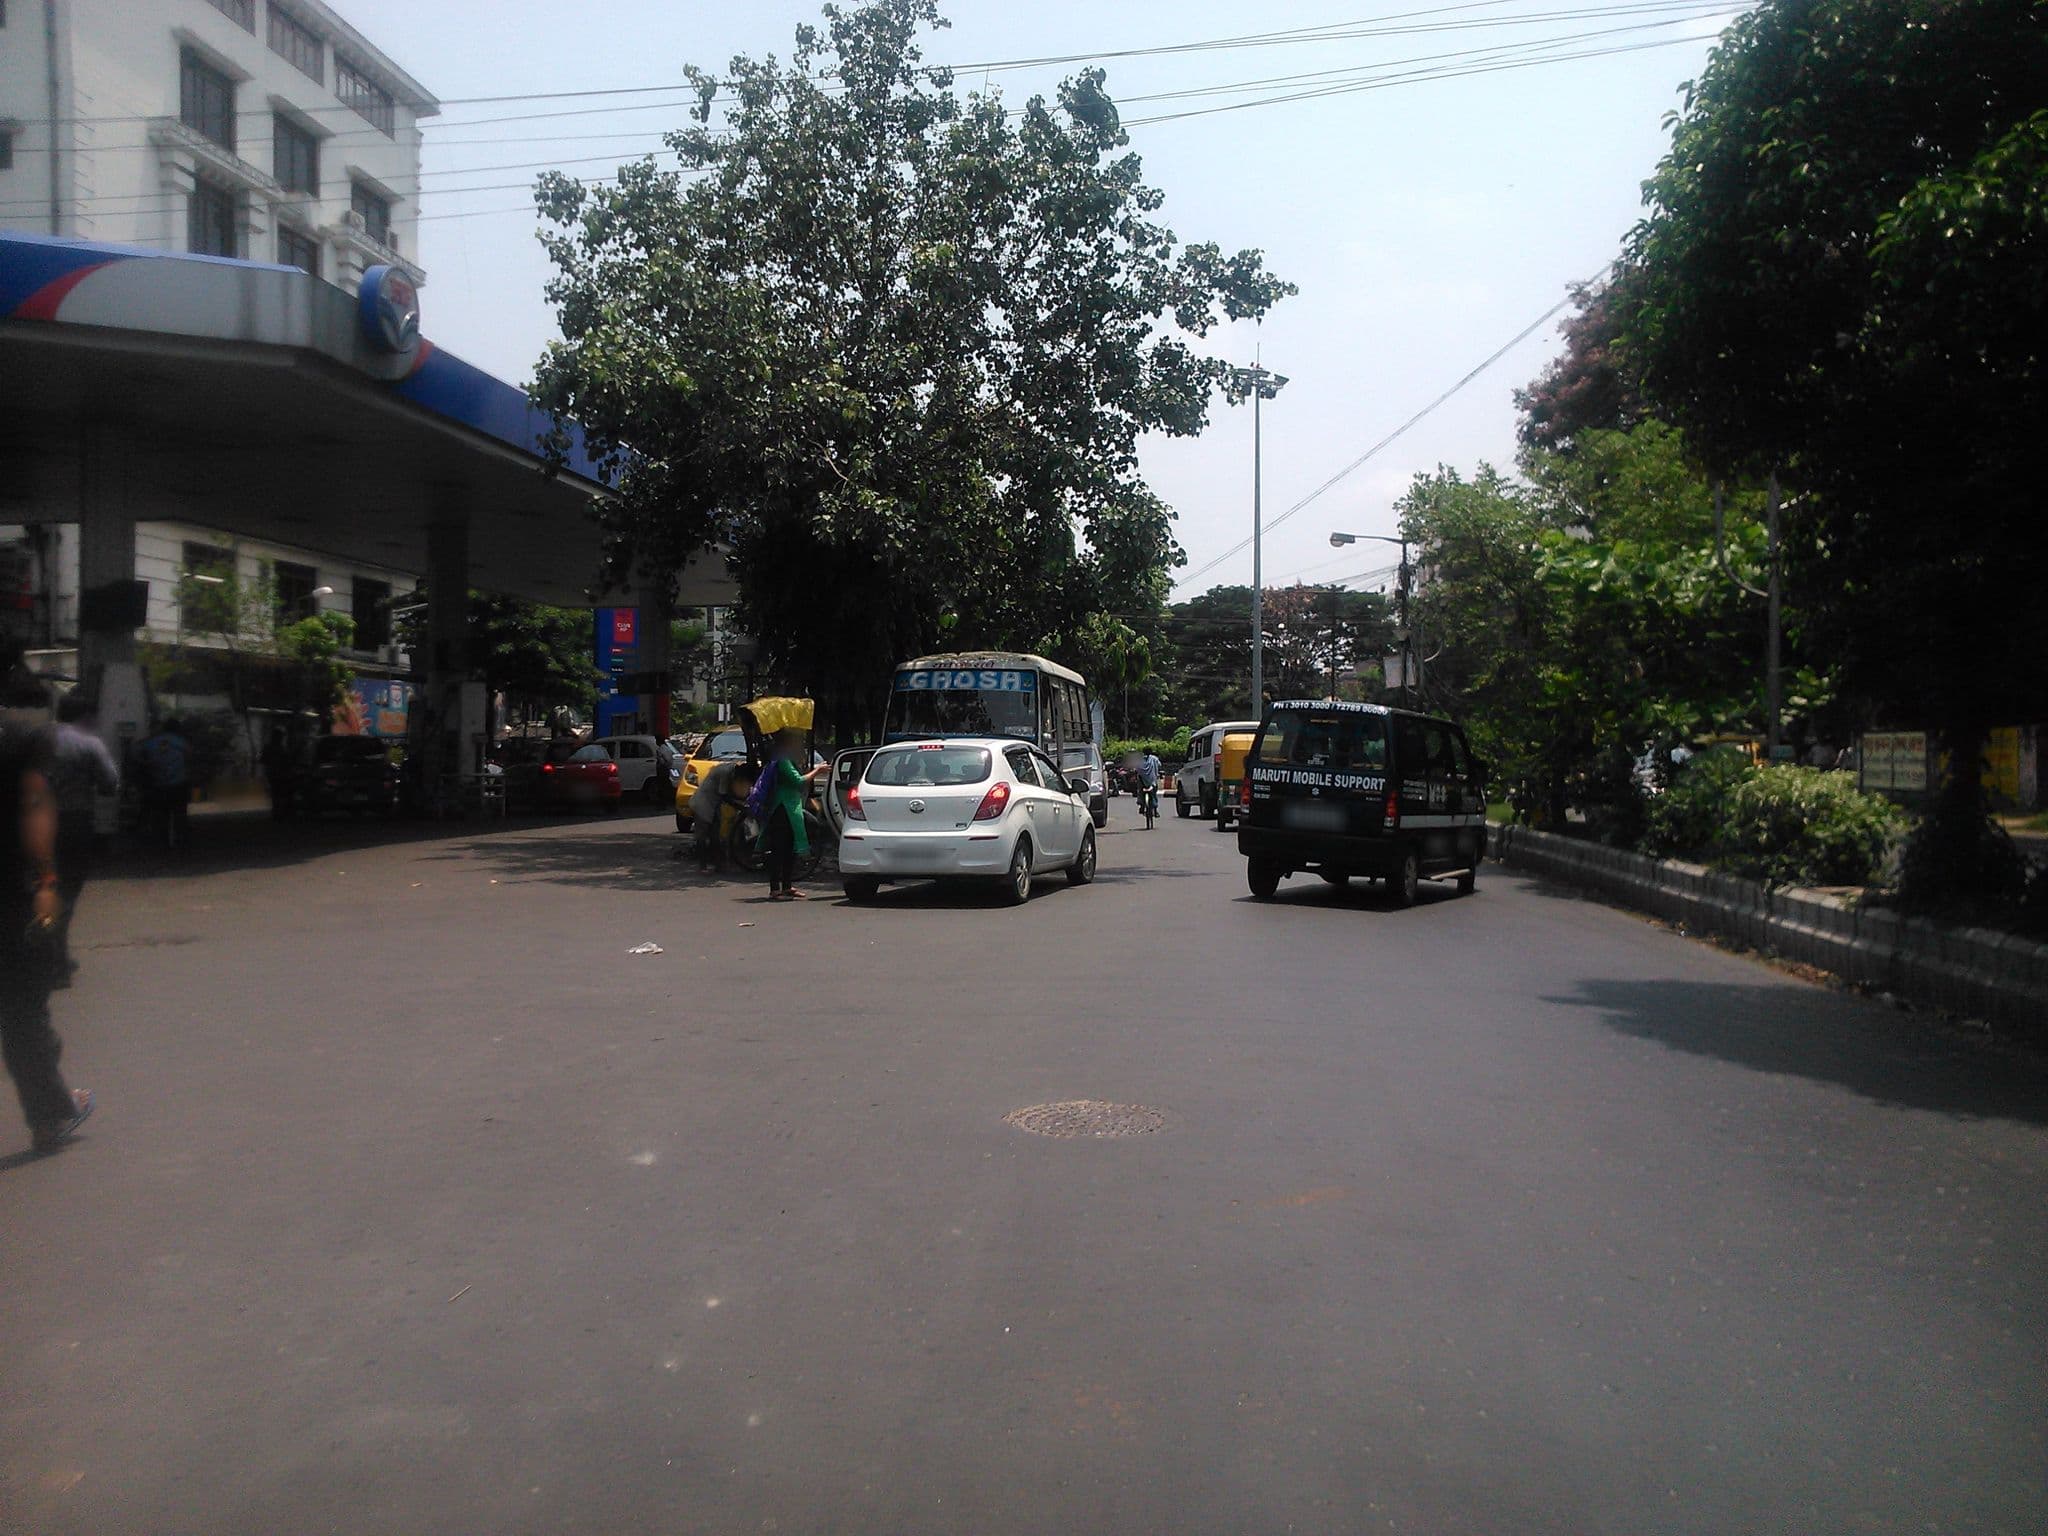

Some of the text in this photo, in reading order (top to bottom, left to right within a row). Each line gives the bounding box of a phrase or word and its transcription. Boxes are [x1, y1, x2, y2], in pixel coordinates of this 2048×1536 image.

[1290, 701, 1309, 709] 3010
[1310, 702, 1329, 710] 3000
[1252, 768, 1290, 783] MARUTI
[1292, 771, 1333, 787] MOBILE
[1334, 774, 1386, 791] SUPPORT
